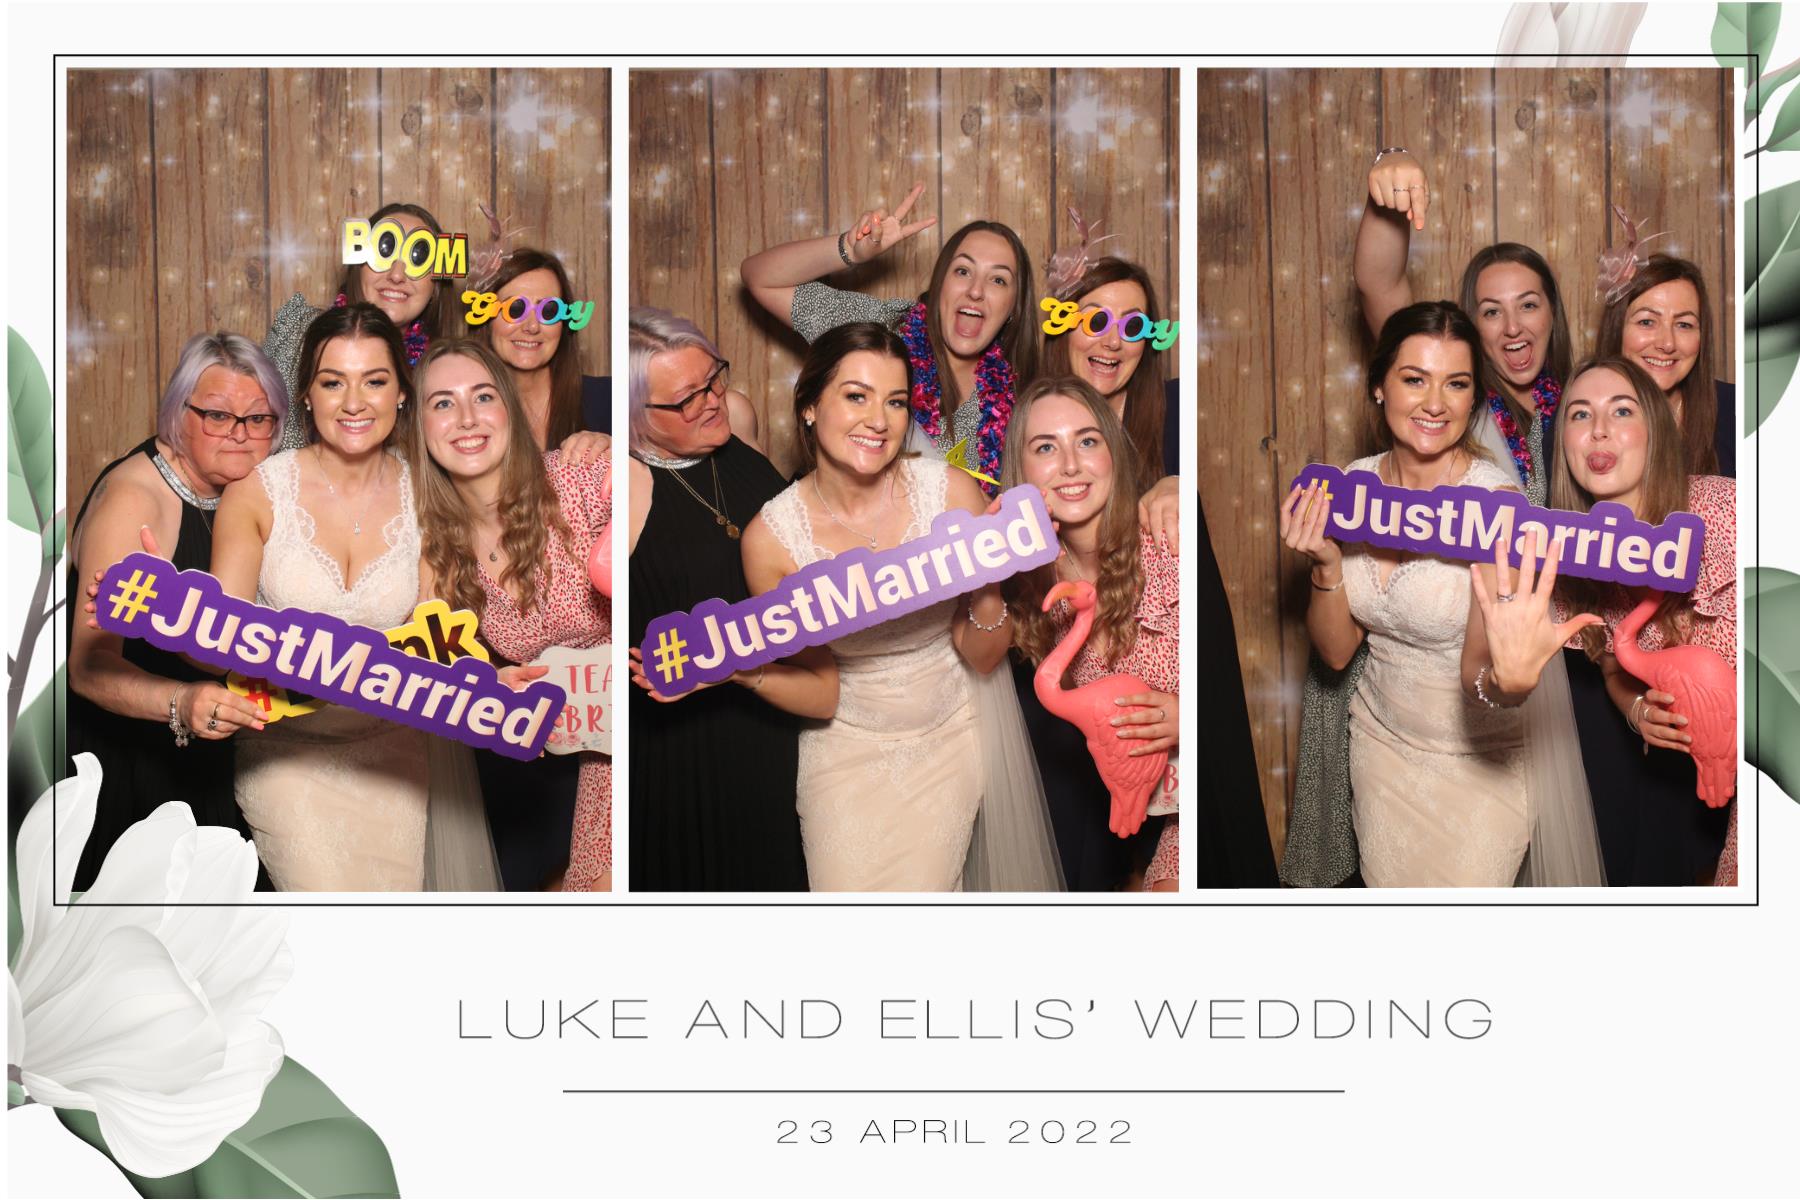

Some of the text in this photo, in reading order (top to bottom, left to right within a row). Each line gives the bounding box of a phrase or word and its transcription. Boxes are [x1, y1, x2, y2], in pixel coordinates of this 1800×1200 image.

[342, 217, 470, 280] BOOM
[108, 569, 553, 749] #JustMarried
[652, 498, 1048, 684] #JustMarried
